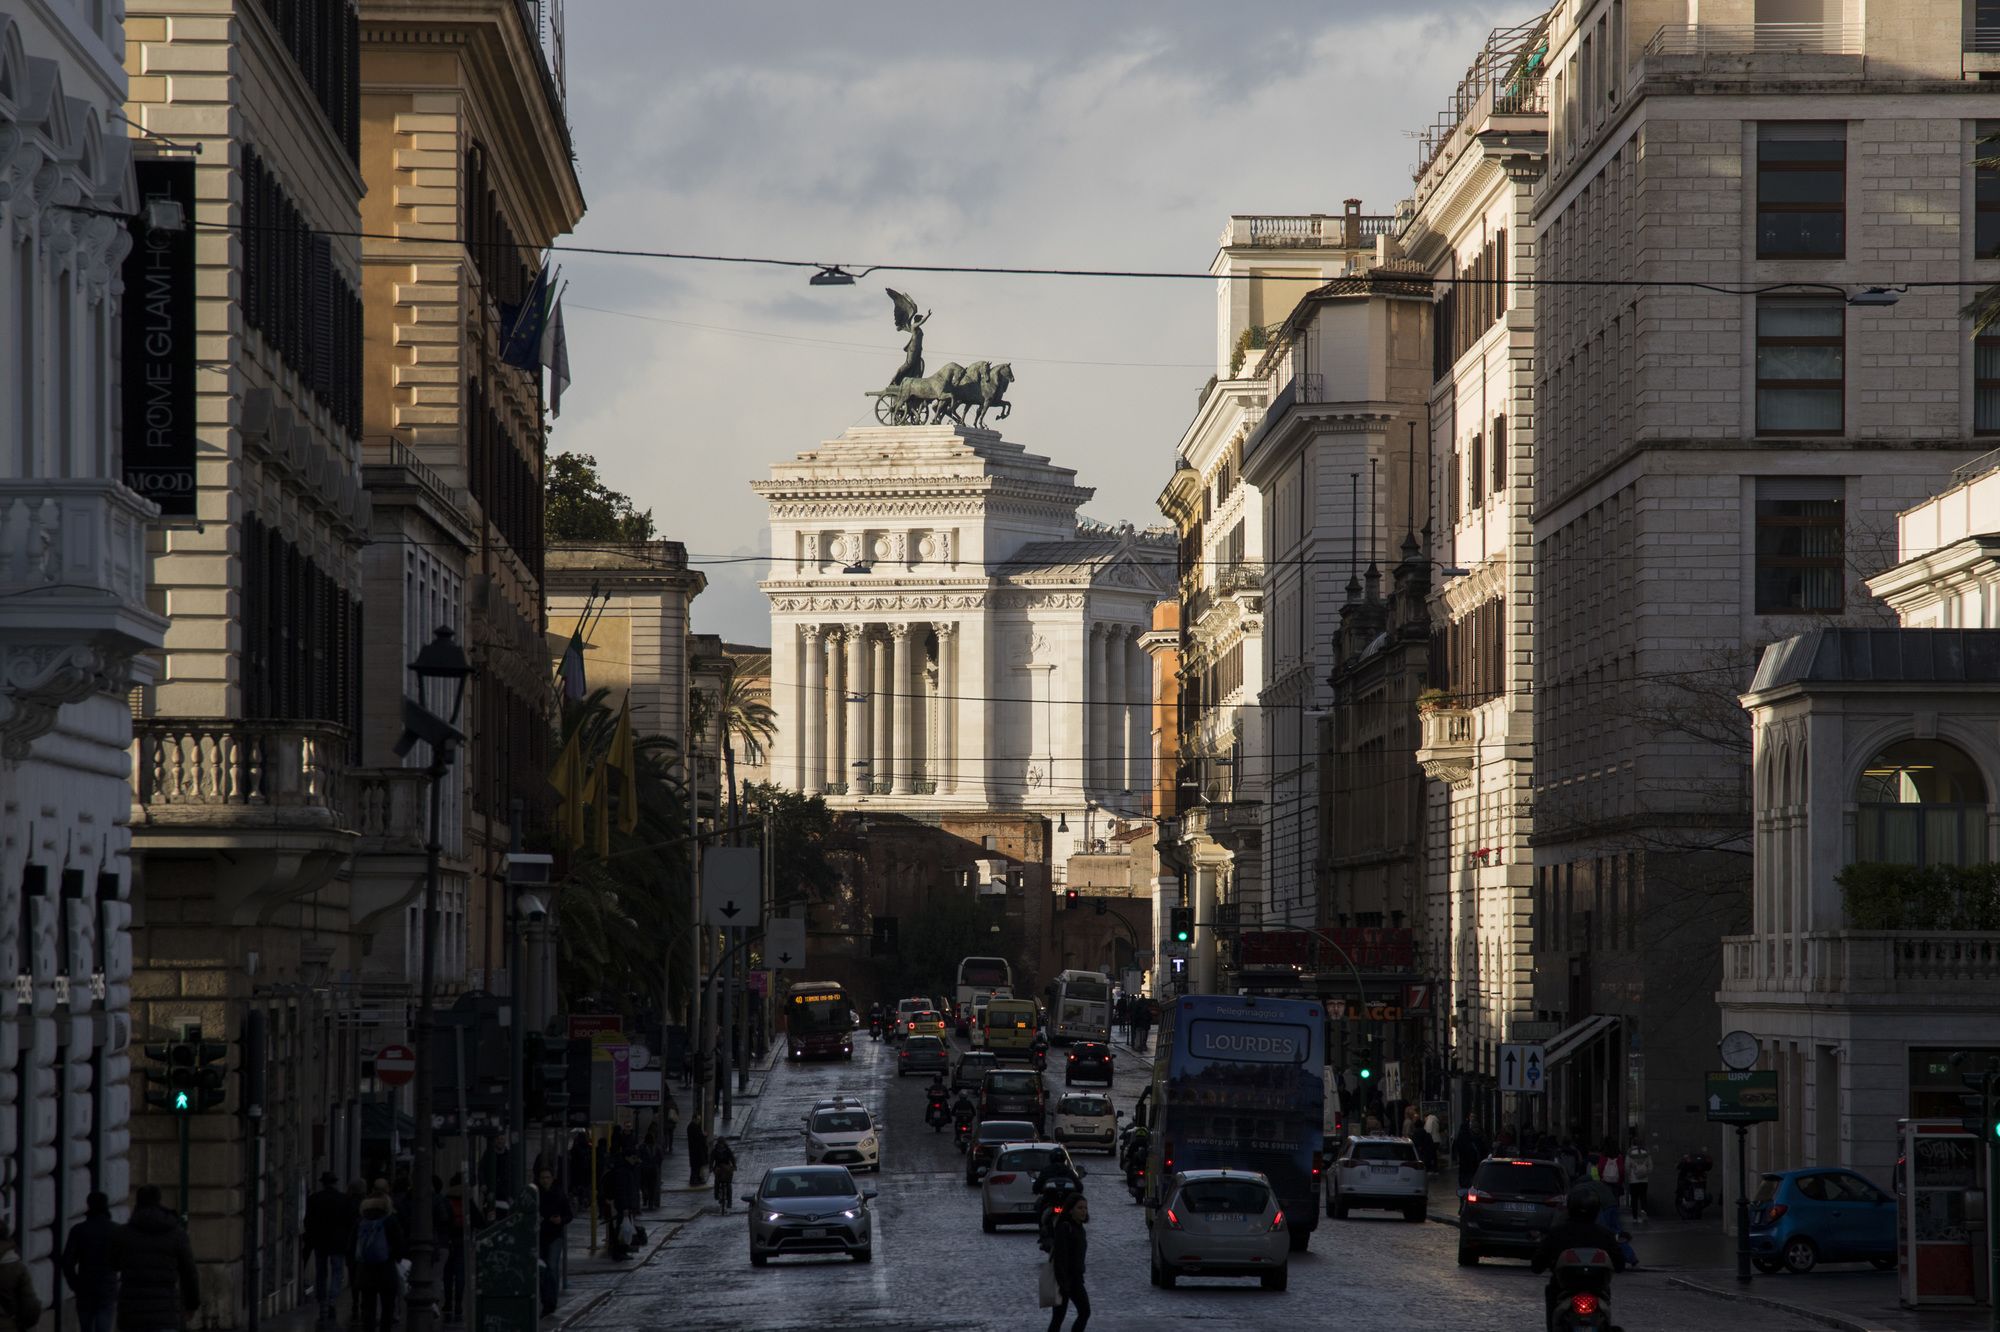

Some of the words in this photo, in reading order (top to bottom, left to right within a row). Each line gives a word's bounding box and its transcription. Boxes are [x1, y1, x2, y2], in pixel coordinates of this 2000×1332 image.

[145, 180, 173, 270] HOL
[145, 275, 172, 356] GLAM
[146, 363, 173, 447] ROME
[127, 472, 194, 491] MOOD
[1172, 959, 1185, 973] T
[795, 995, 803, 1004] 40
[1411, 984, 1427, 1009] 7
[1216, 1006, 1278, 1019] Pellegrinaggio
[1204, 1033, 1293, 1054] LOURDES
[1708, 1072, 1753, 1081] SUBWAY
